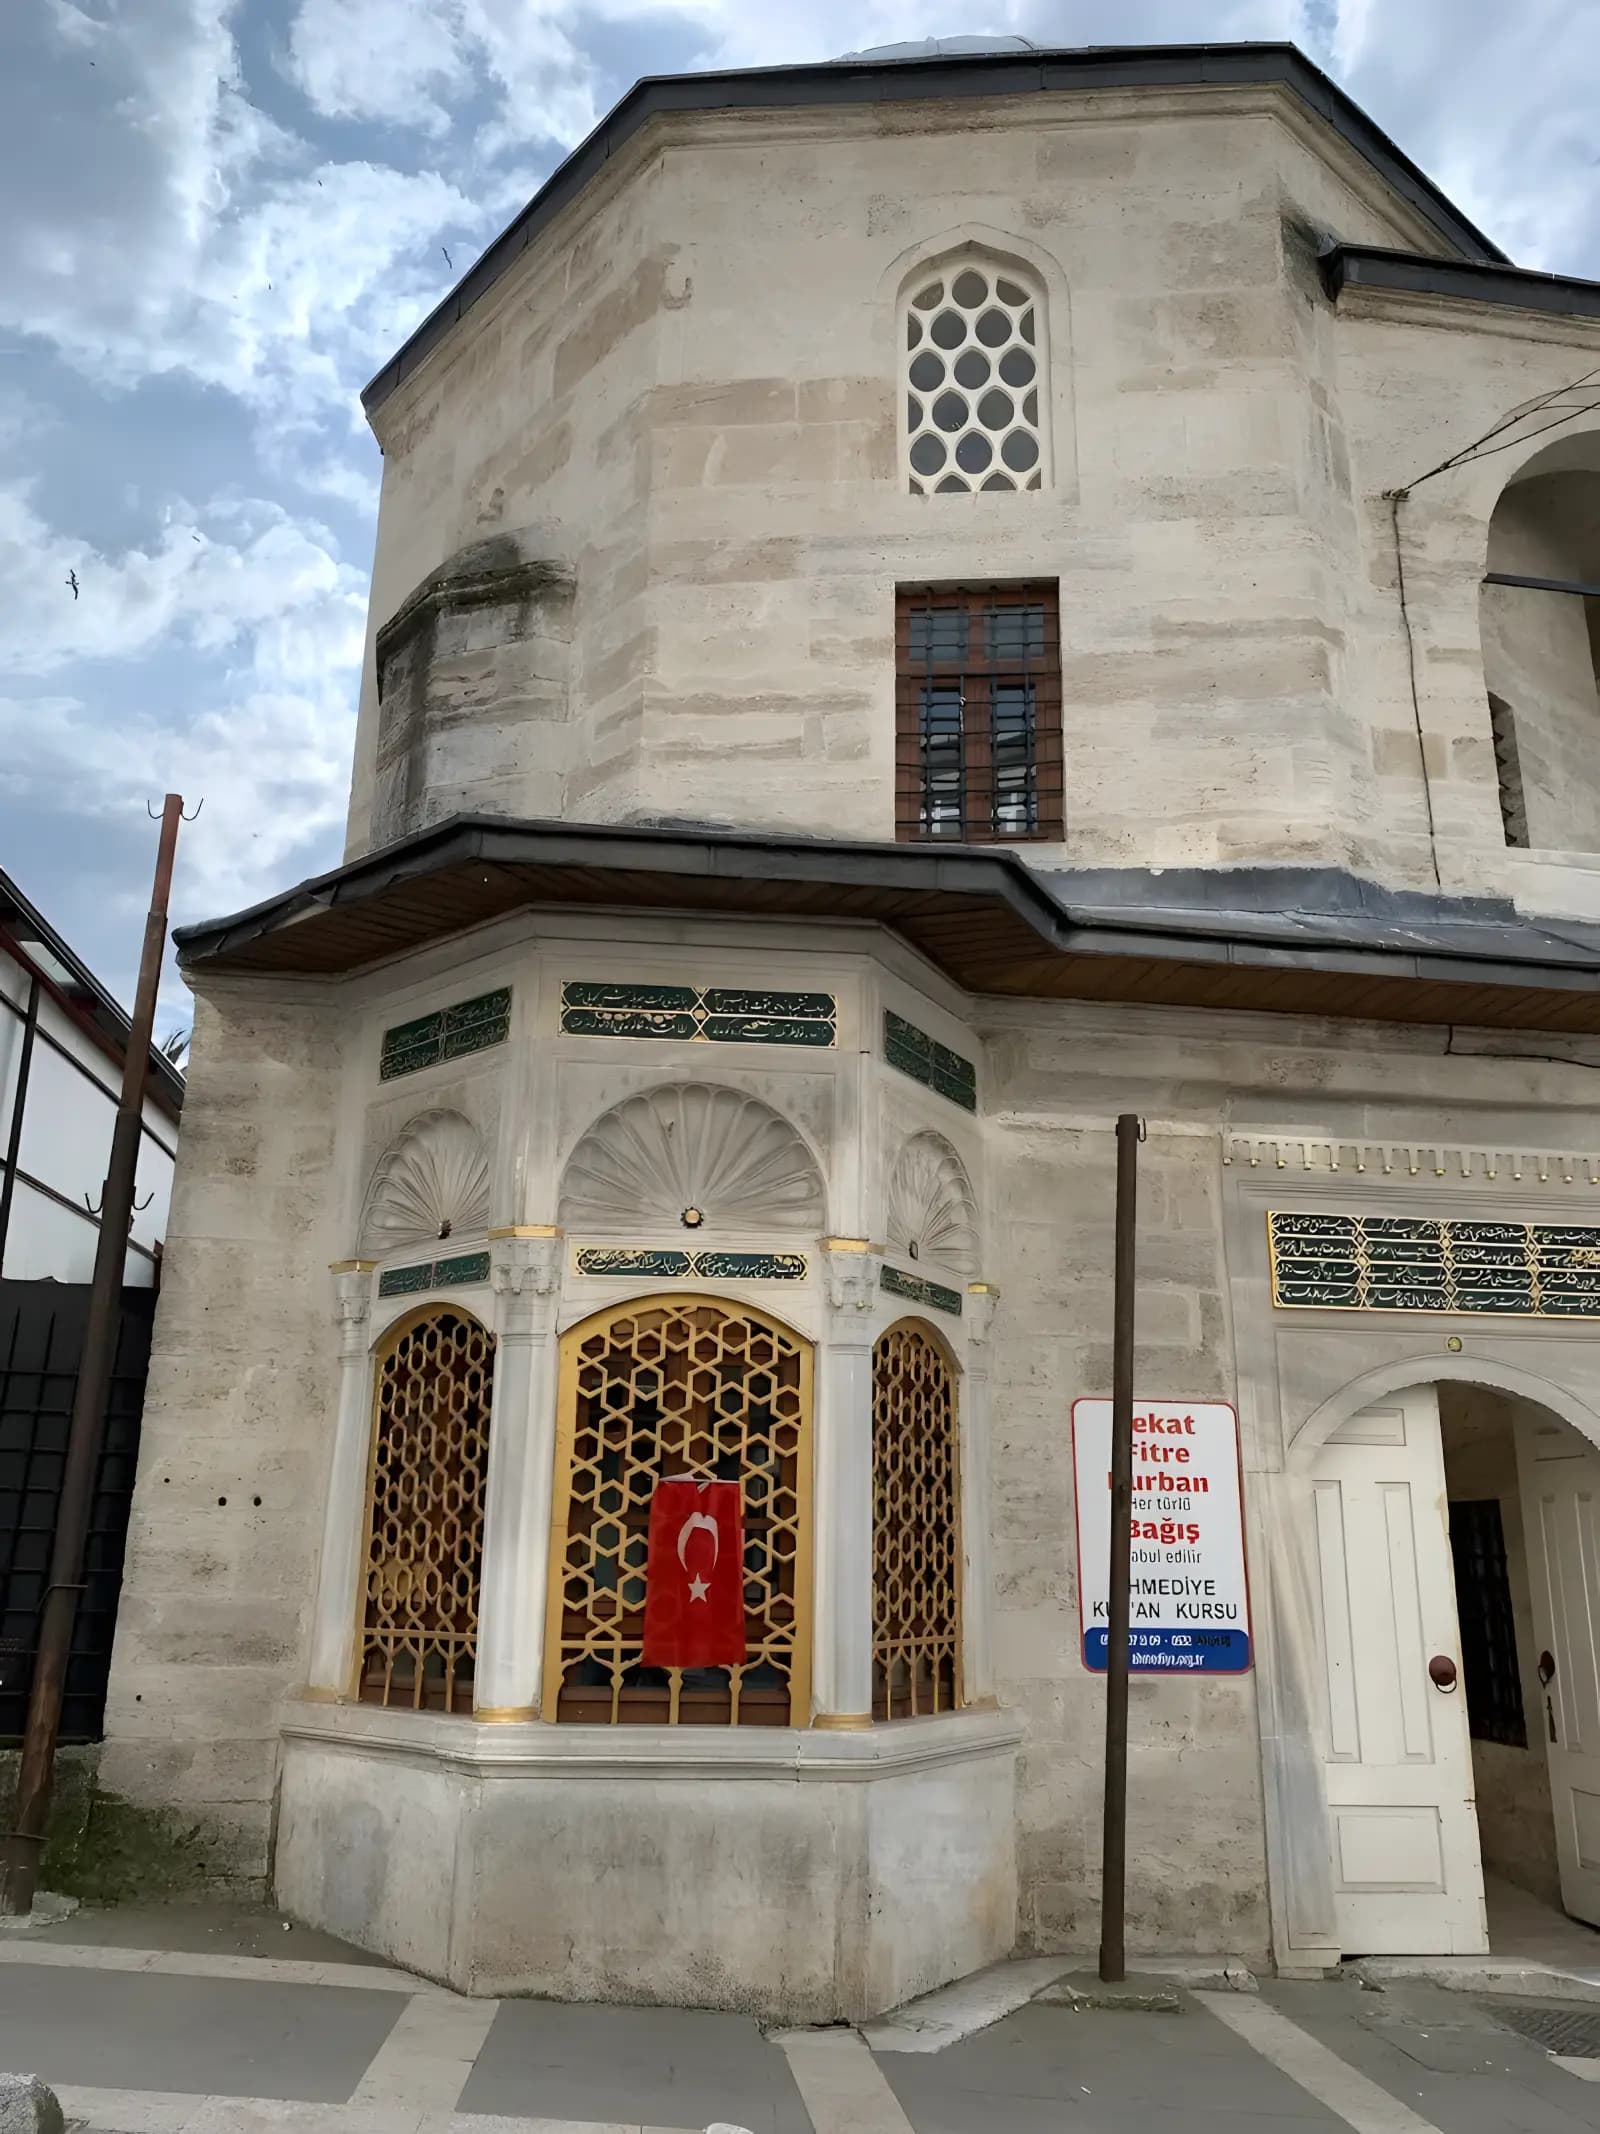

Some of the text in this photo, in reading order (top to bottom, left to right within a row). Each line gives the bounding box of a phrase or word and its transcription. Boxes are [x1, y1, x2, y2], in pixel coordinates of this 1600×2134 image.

[1132, 1413, 1196, 1435] ekat
[1131, 1549, 1201, 1563] abul edilir
[1129, 1576, 1216, 1596] HMEDİYE
[1176, 1603, 1237, 1619] KURSU
